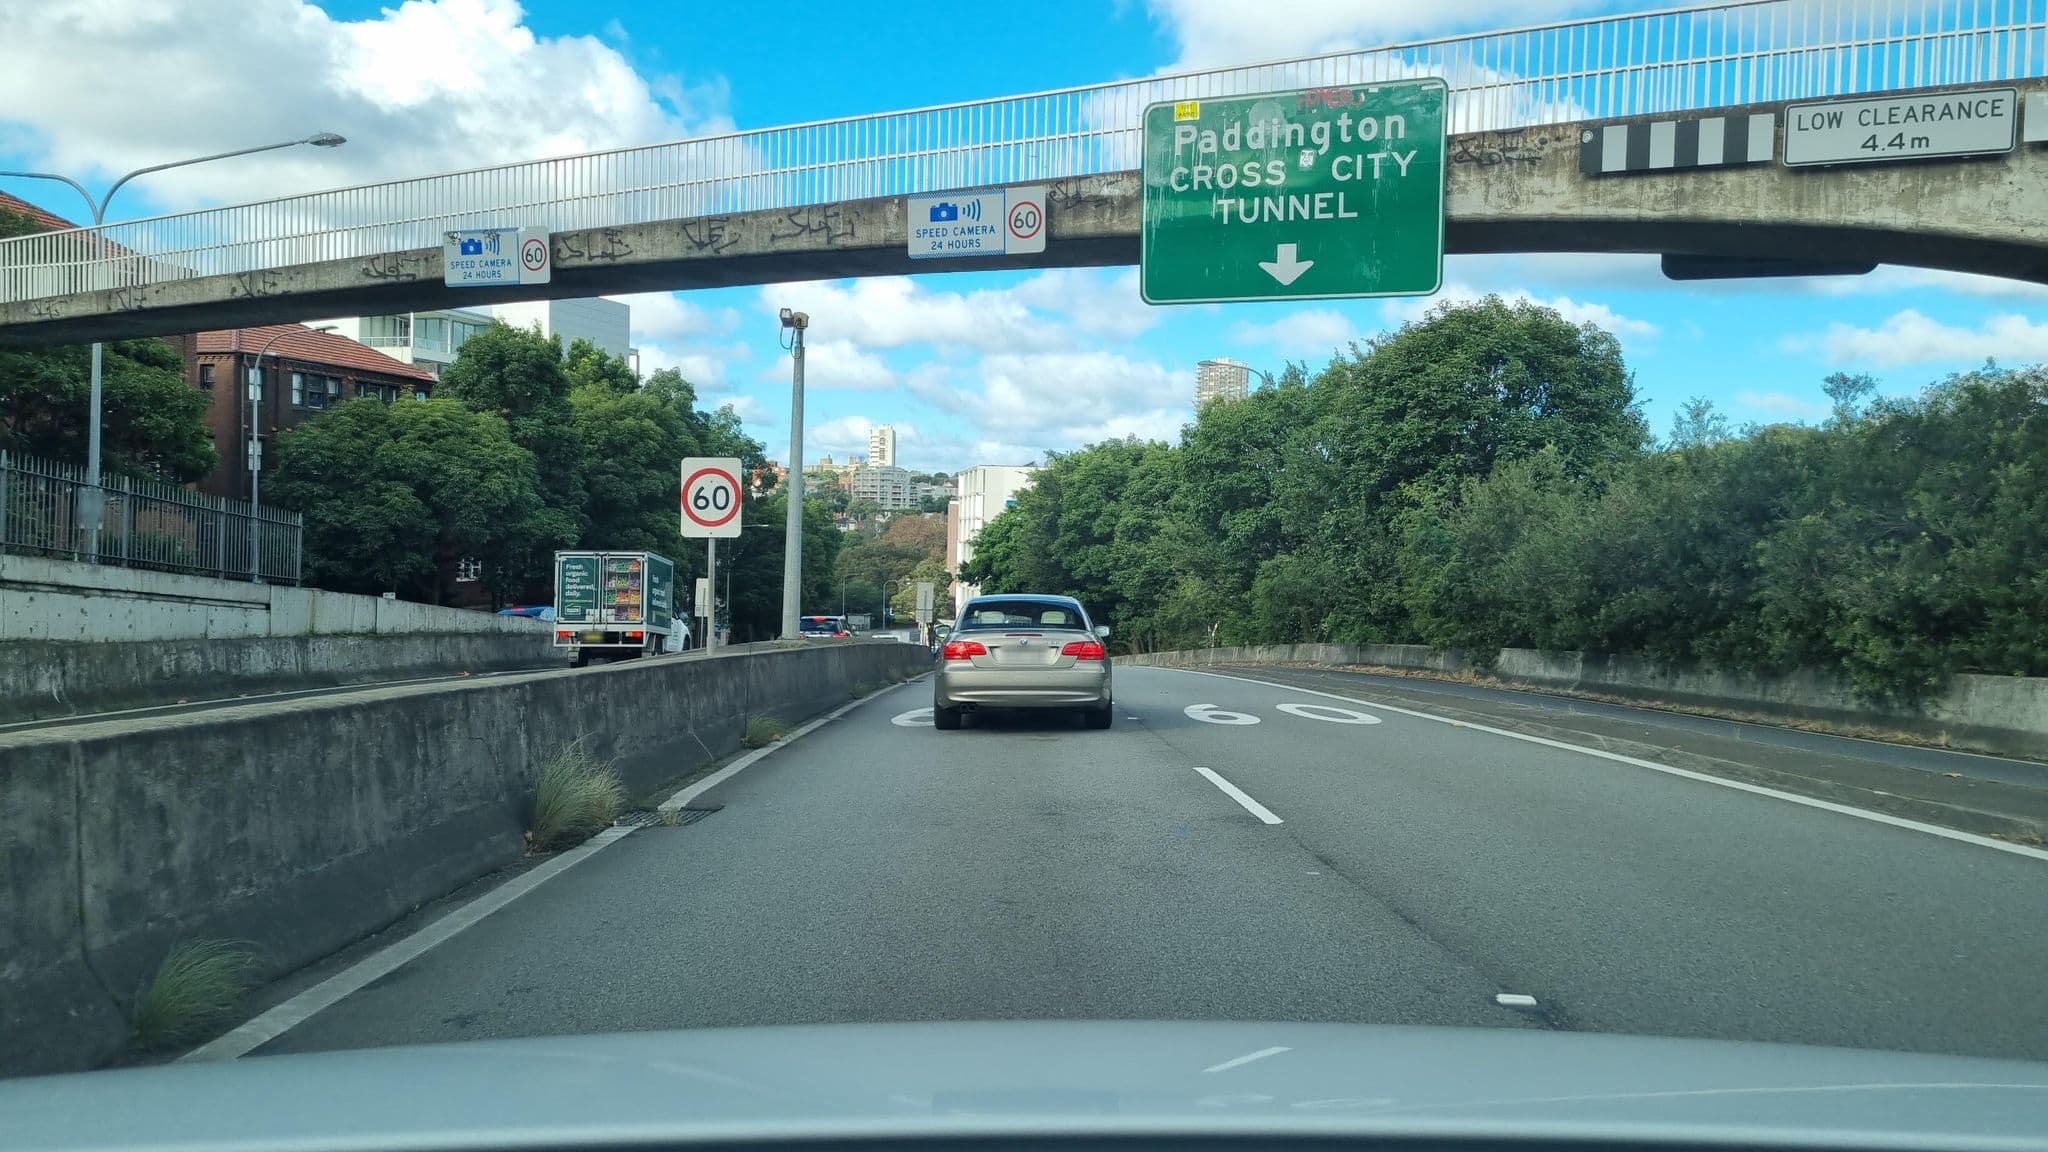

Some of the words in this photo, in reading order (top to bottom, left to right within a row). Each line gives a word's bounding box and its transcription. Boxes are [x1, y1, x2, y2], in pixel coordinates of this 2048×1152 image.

[1797, 110, 1843, 132] LOW
[1858, 98, 2004, 127] CLEARANCE
[1174, 111, 1405, 156] Paddington
[1860, 132, 1930, 152] 4.4m
[1170, 160, 1286, 192] CROSS
[1331, 150, 1417, 181] CITY
[1217, 192, 1358, 225] TUNNEL
[1013, 210, 1037, 229] 60
[916, 227, 948, 239] SPEED
[953, 225, 996, 236] CAMERA
[931, 241, 943, 250] 24
[948, 239, 981, 249] HOURS
[450, 260, 476, 270] SPEED
[479, 259, 512, 269] CAMERA
[525, 247, 543, 263] 60
[463, 271, 473, 280] 24
[475, 270, 502, 279] HOURS
[693, 485, 730, 511] 60
[565, 563, 584, 571] Fresh
[1184, 702, 1383, 725] 60
